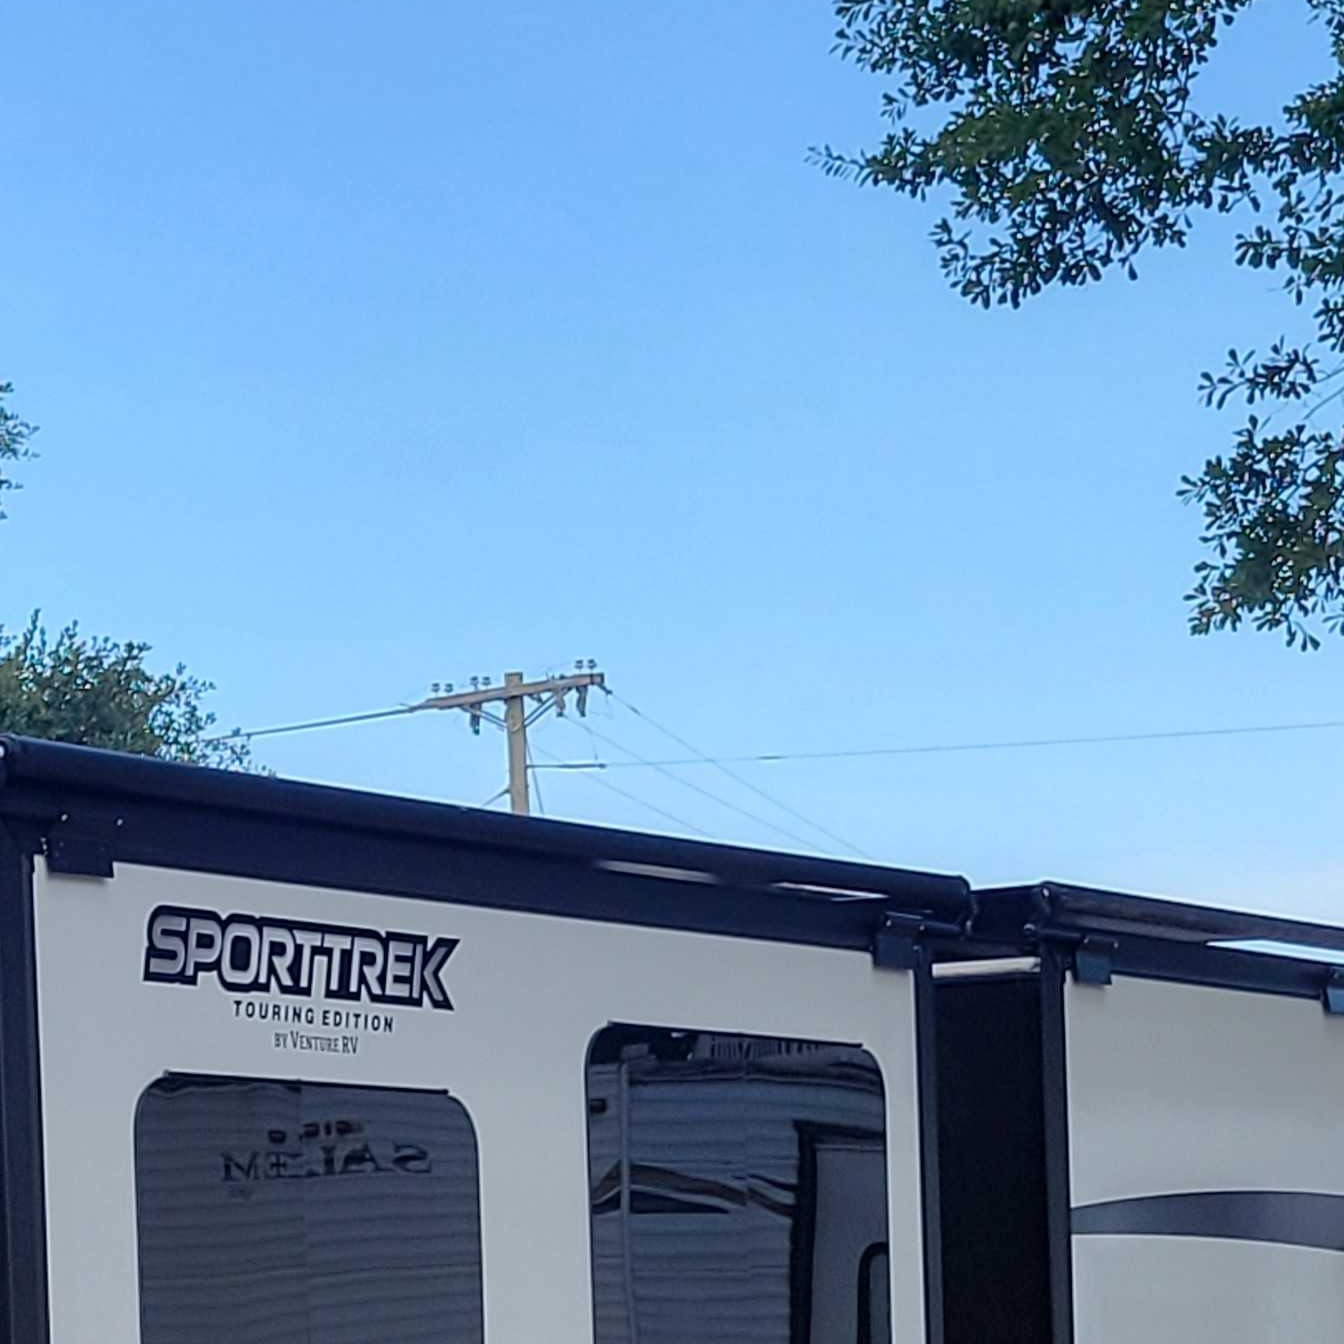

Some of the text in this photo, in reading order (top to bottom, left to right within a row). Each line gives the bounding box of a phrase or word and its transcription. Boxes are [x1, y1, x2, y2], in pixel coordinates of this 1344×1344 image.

[144, 905, 460, 1011] SPORTTREK
[233, 1000, 394, 1032] TOURING EDITION
[342, 1036, 359, 1054] RV
